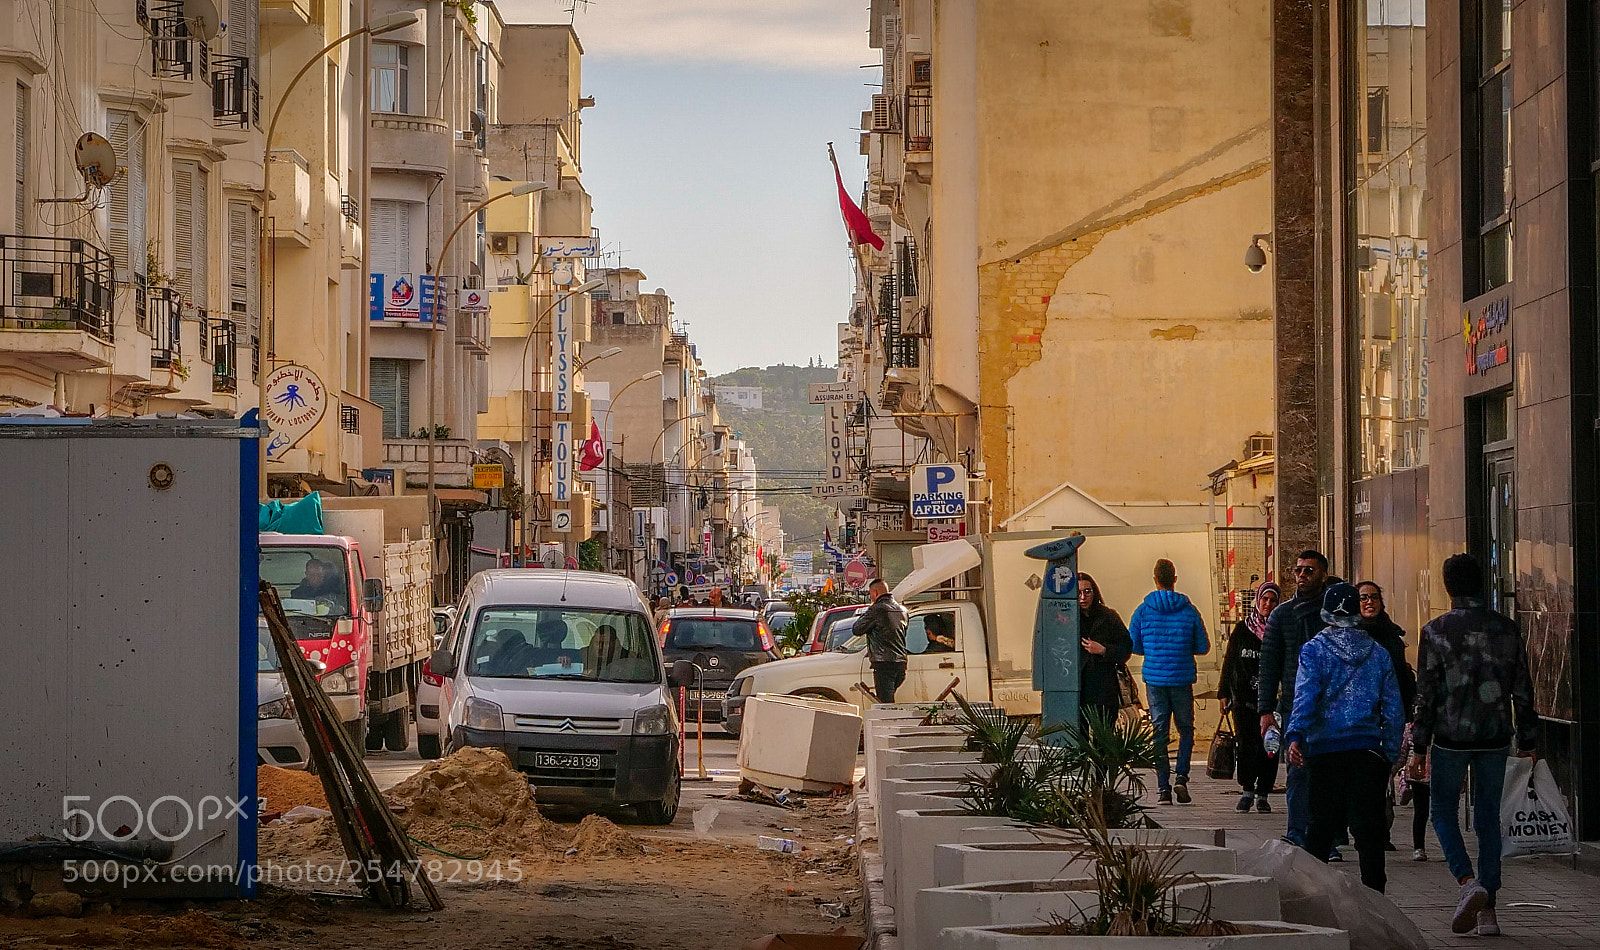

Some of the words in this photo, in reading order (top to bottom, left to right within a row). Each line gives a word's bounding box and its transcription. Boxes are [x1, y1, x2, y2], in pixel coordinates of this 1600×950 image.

[557, 294, 567, 411] ULYSSE
[831, 406, 841, 479] LLOYD
[557, 423, 568, 500] TOUR
[926, 466, 956, 494] P
[913, 491, 964, 501] PARKING
[914, 504, 964, 515] AFRICA
[538, 754, 556, 766] 136
[572, 756, 599, 767] 8199
[1515, 810, 1558, 822] CASH
[1509, 822, 1568, 837] MONEY
